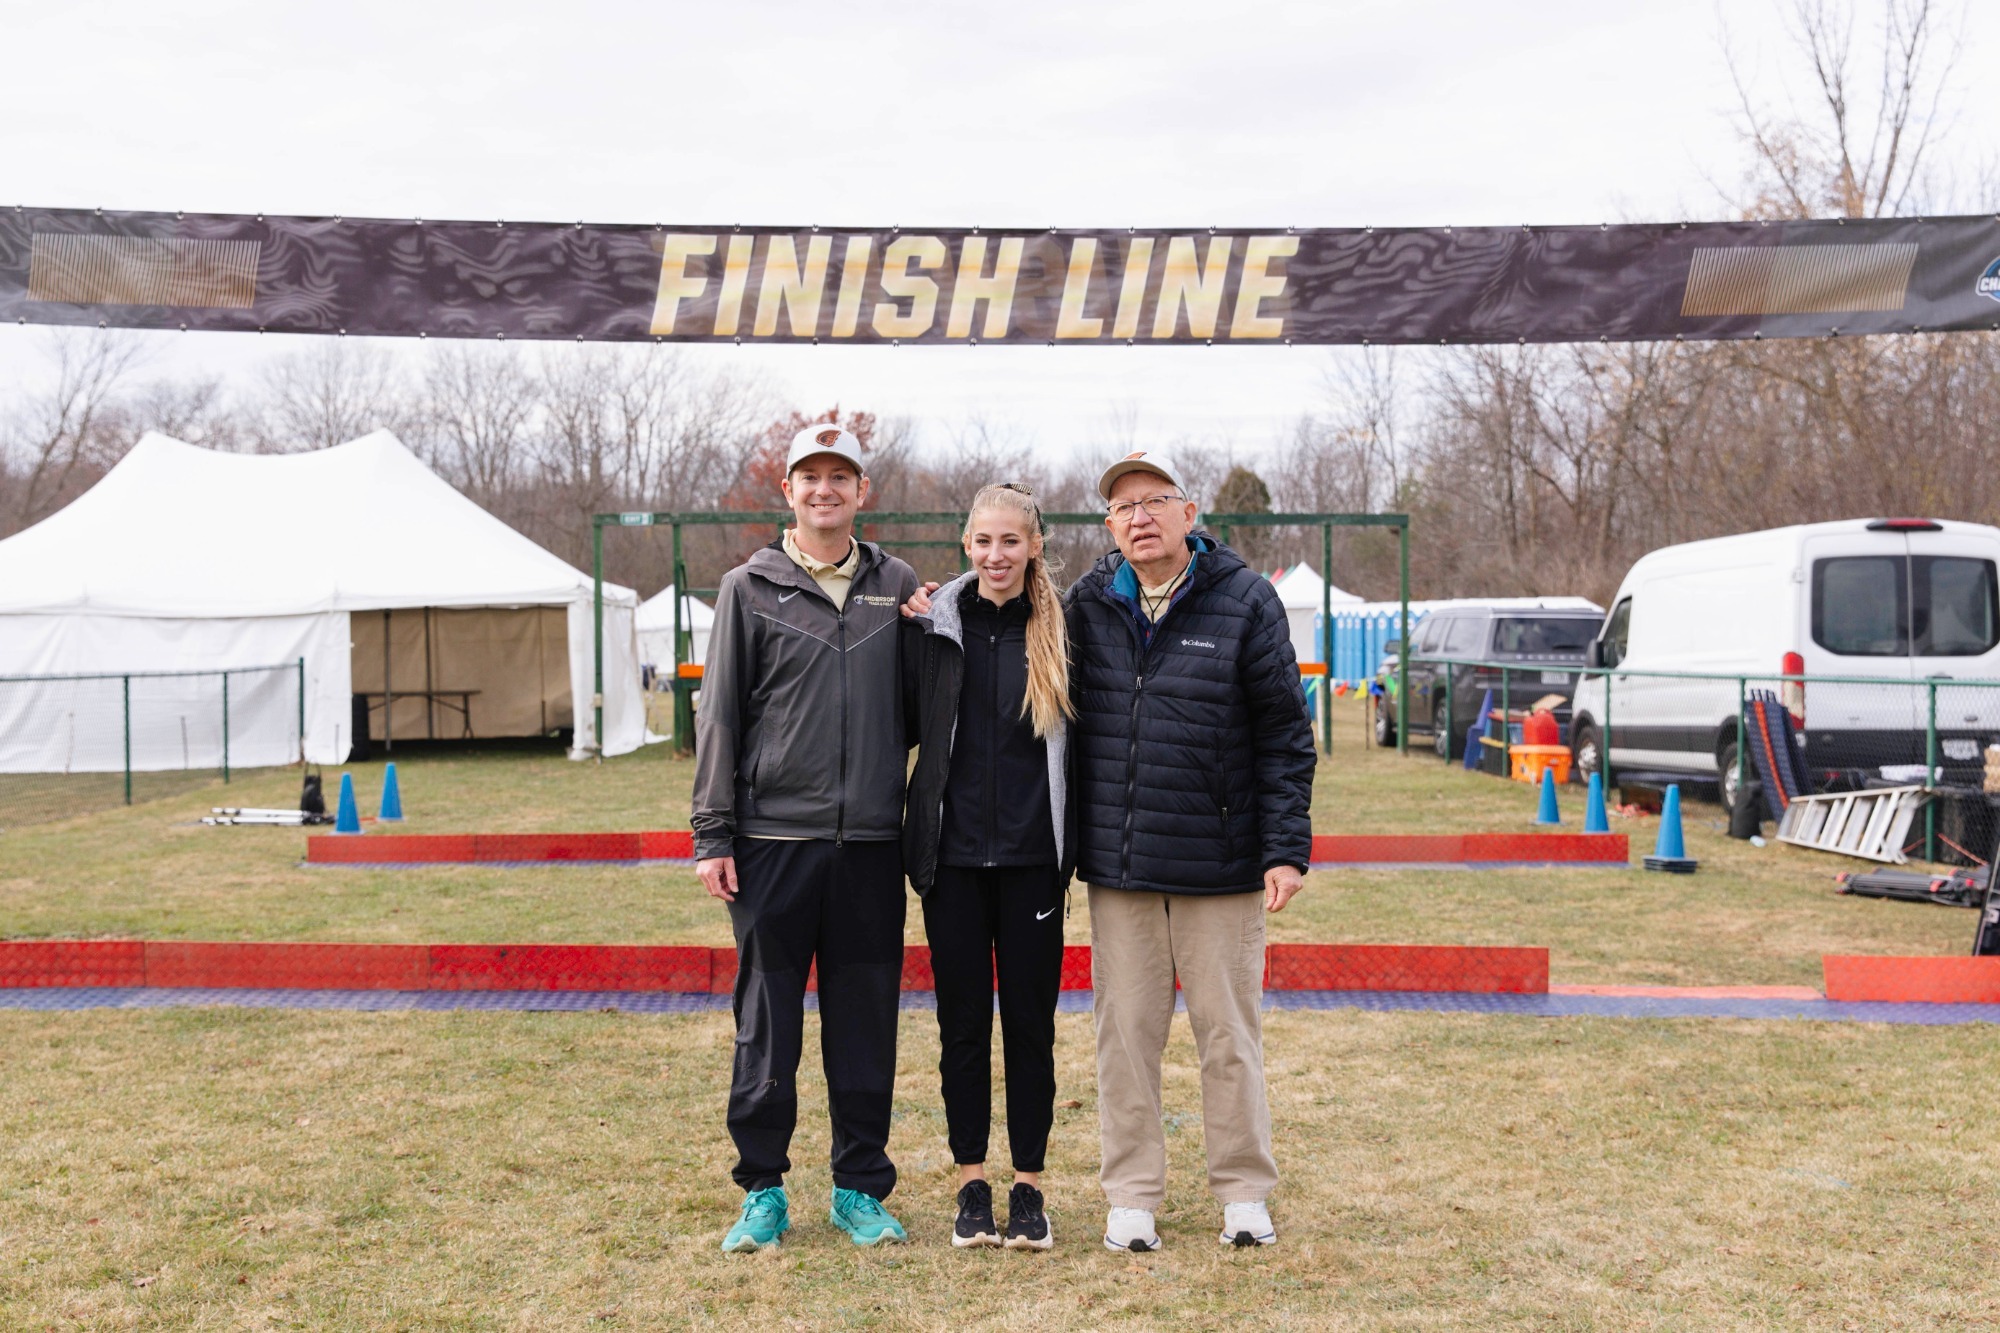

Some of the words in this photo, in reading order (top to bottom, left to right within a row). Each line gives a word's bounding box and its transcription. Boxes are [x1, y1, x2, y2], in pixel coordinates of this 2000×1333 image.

[649, 234, 1025, 338] FINISH
[1055, 236, 1300, 339] LINE
[1980, 276, 2000, 291] CH
[1187, 639, 1215, 649] Columbia
